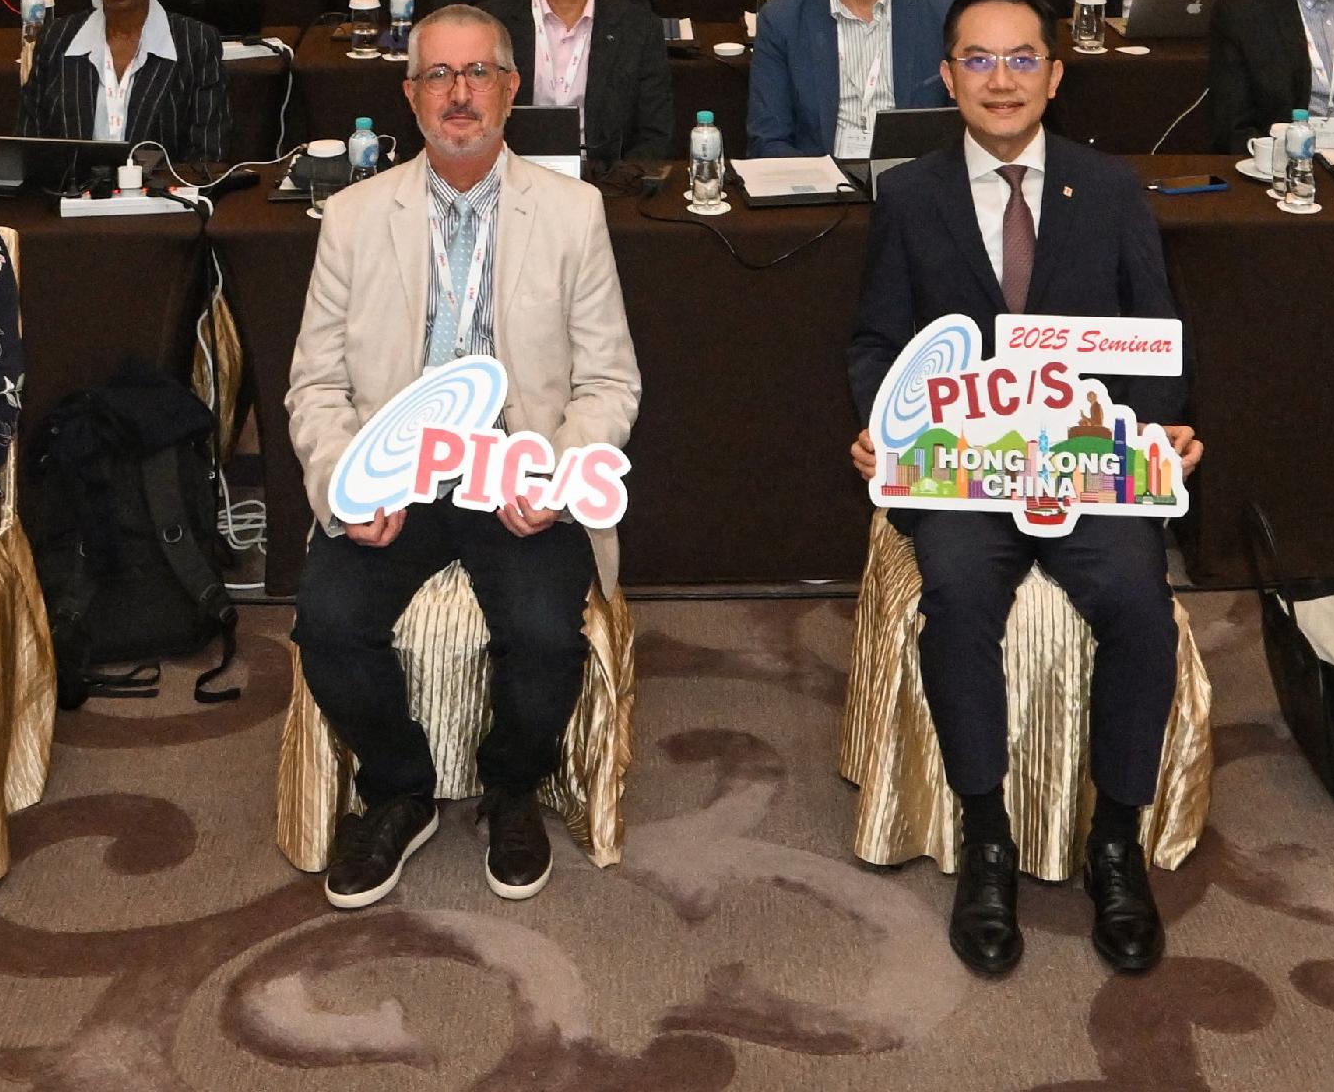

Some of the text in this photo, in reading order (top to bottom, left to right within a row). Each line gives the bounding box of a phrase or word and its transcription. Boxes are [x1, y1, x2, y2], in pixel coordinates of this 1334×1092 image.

[1008, 326, 1173, 354] 2025 Seminar
[926, 361, 1075, 425] PIC/S
[413, 426, 623, 521] PIC/S
[938, 446, 1121, 476] HONG KONG
[981, 474, 1077, 499] CHINA
